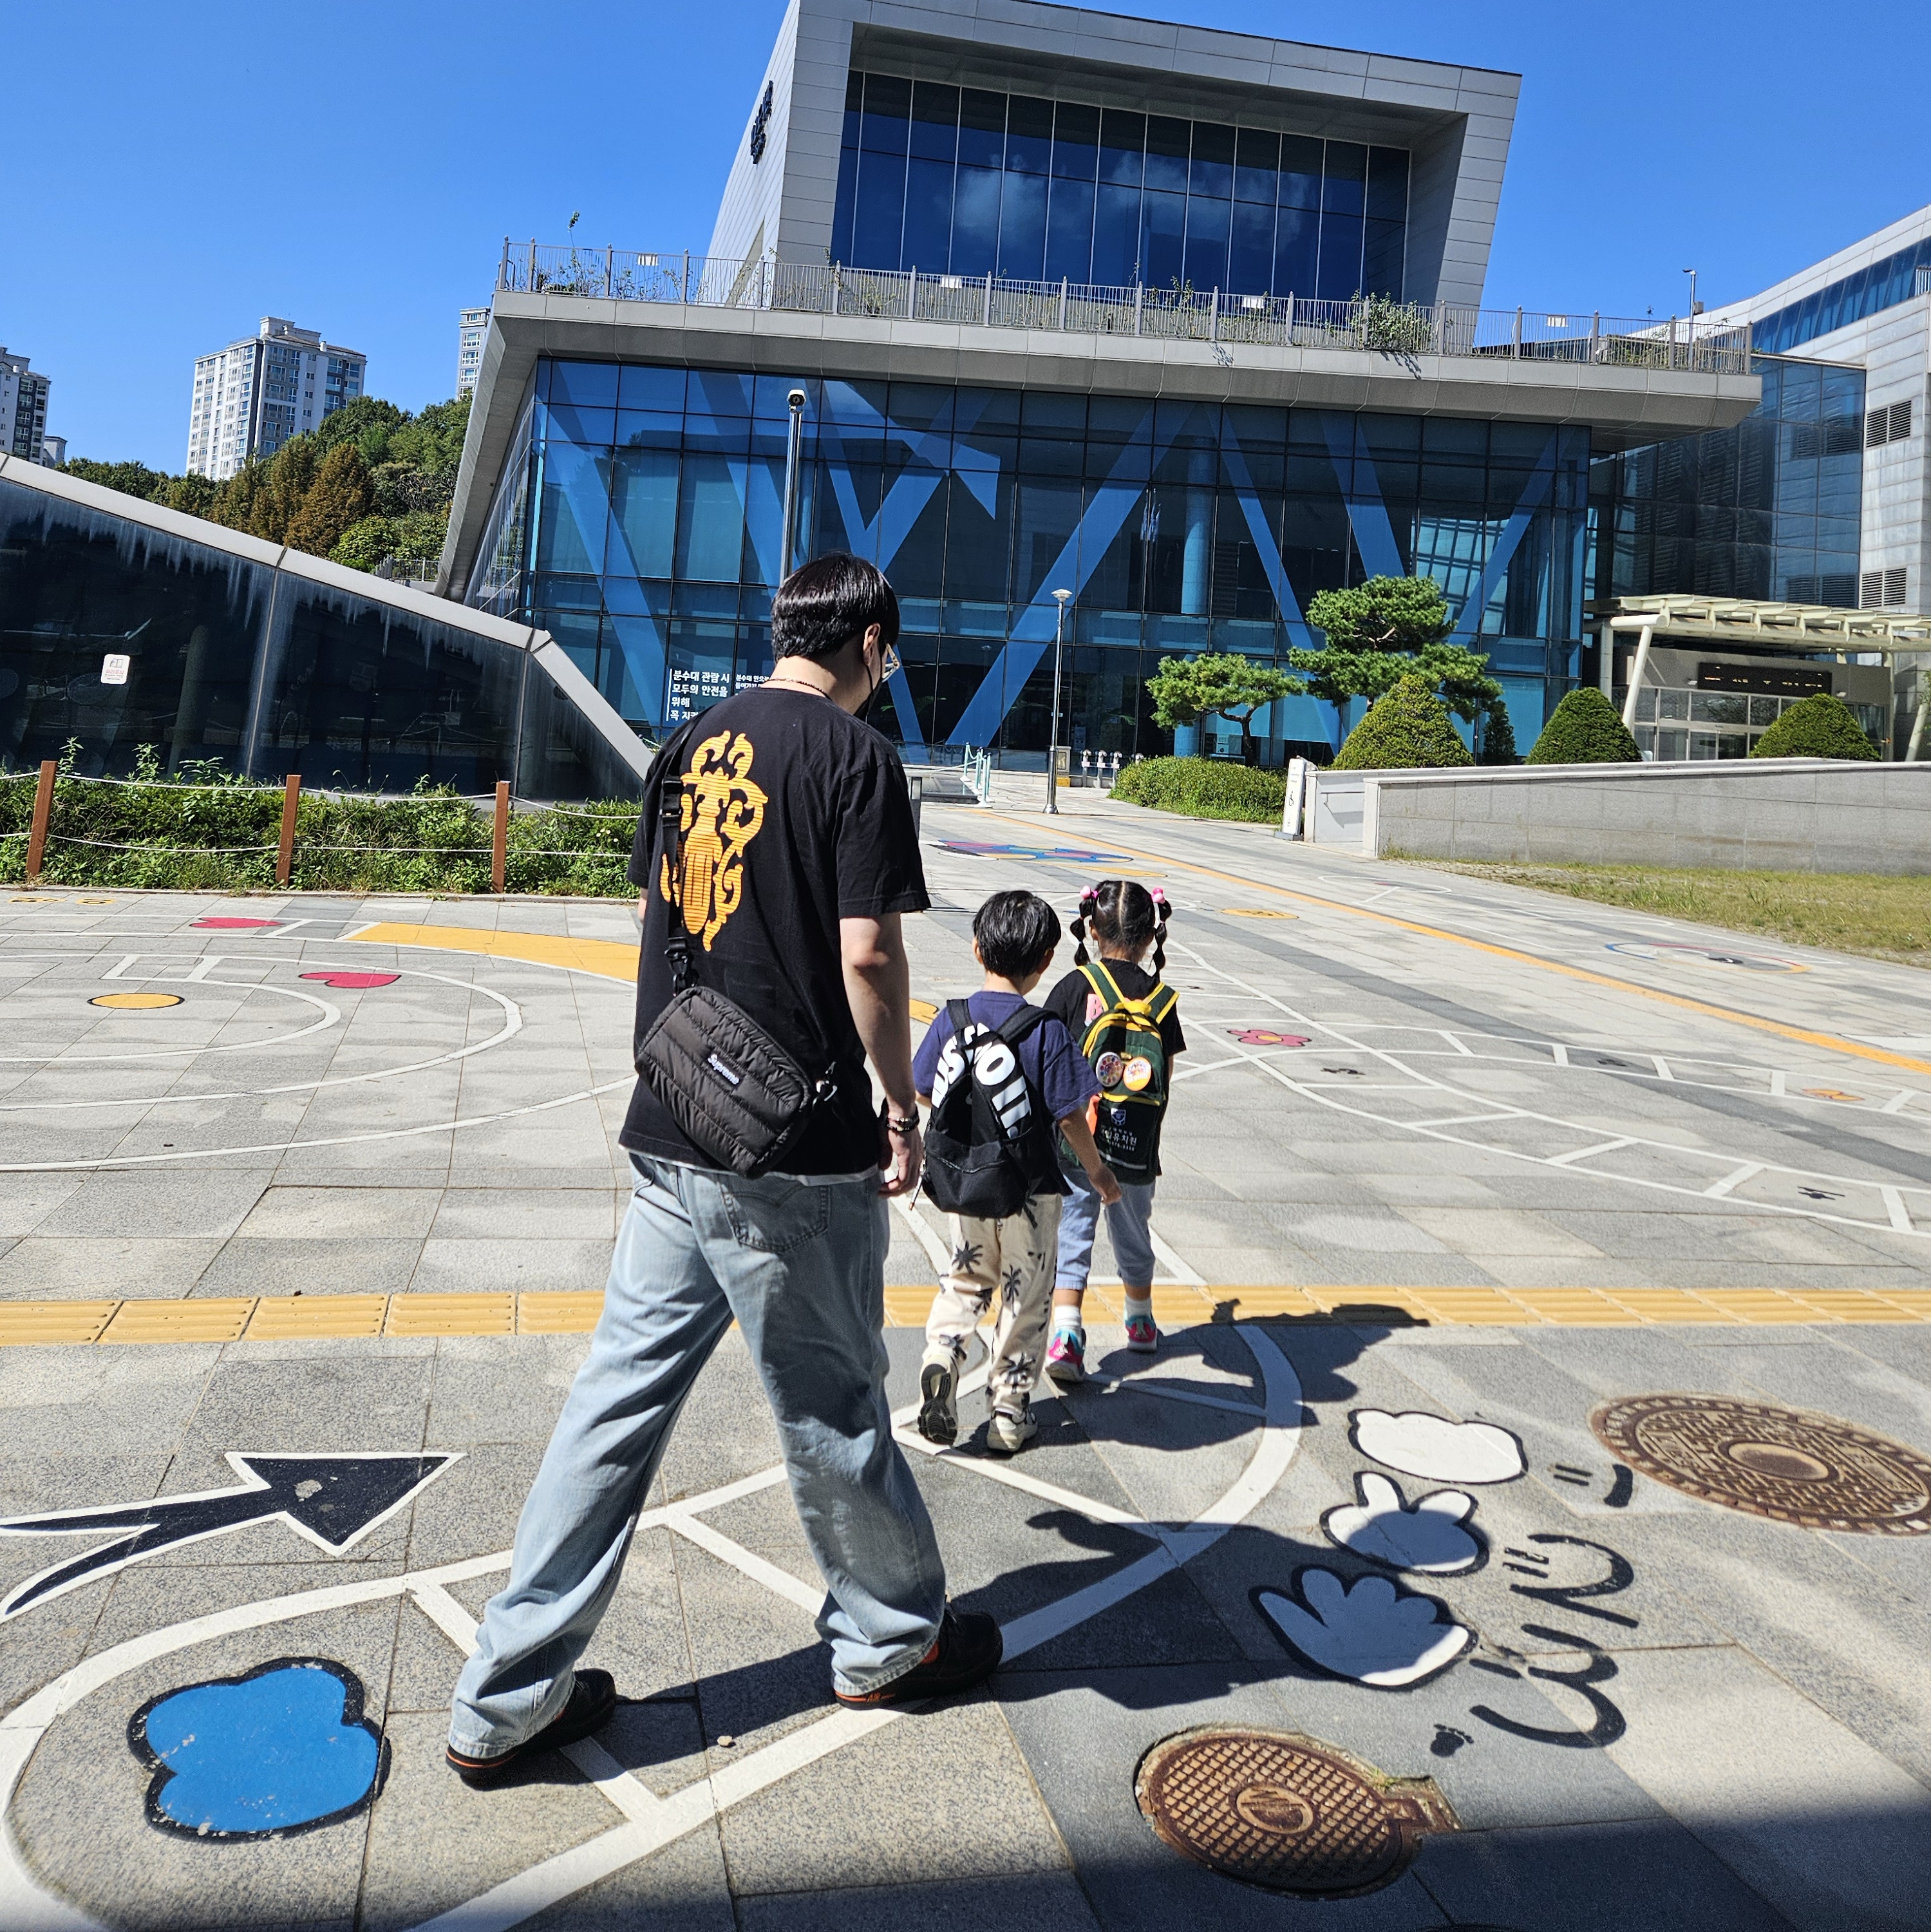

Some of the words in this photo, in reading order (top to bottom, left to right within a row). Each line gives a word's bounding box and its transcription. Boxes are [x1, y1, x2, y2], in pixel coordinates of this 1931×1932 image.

[673, 670, 700, 681] 분수대
[701, 672, 720, 683] 관람
[721, 673, 730, 683] 시
[672, 683, 699, 695] 모두의
[701, 685, 728, 697] 안전을
[671, 696, 690, 707] 위해
[670, 710, 679, 721] 꼭
[708, 1054, 739, 1084] Supreme
